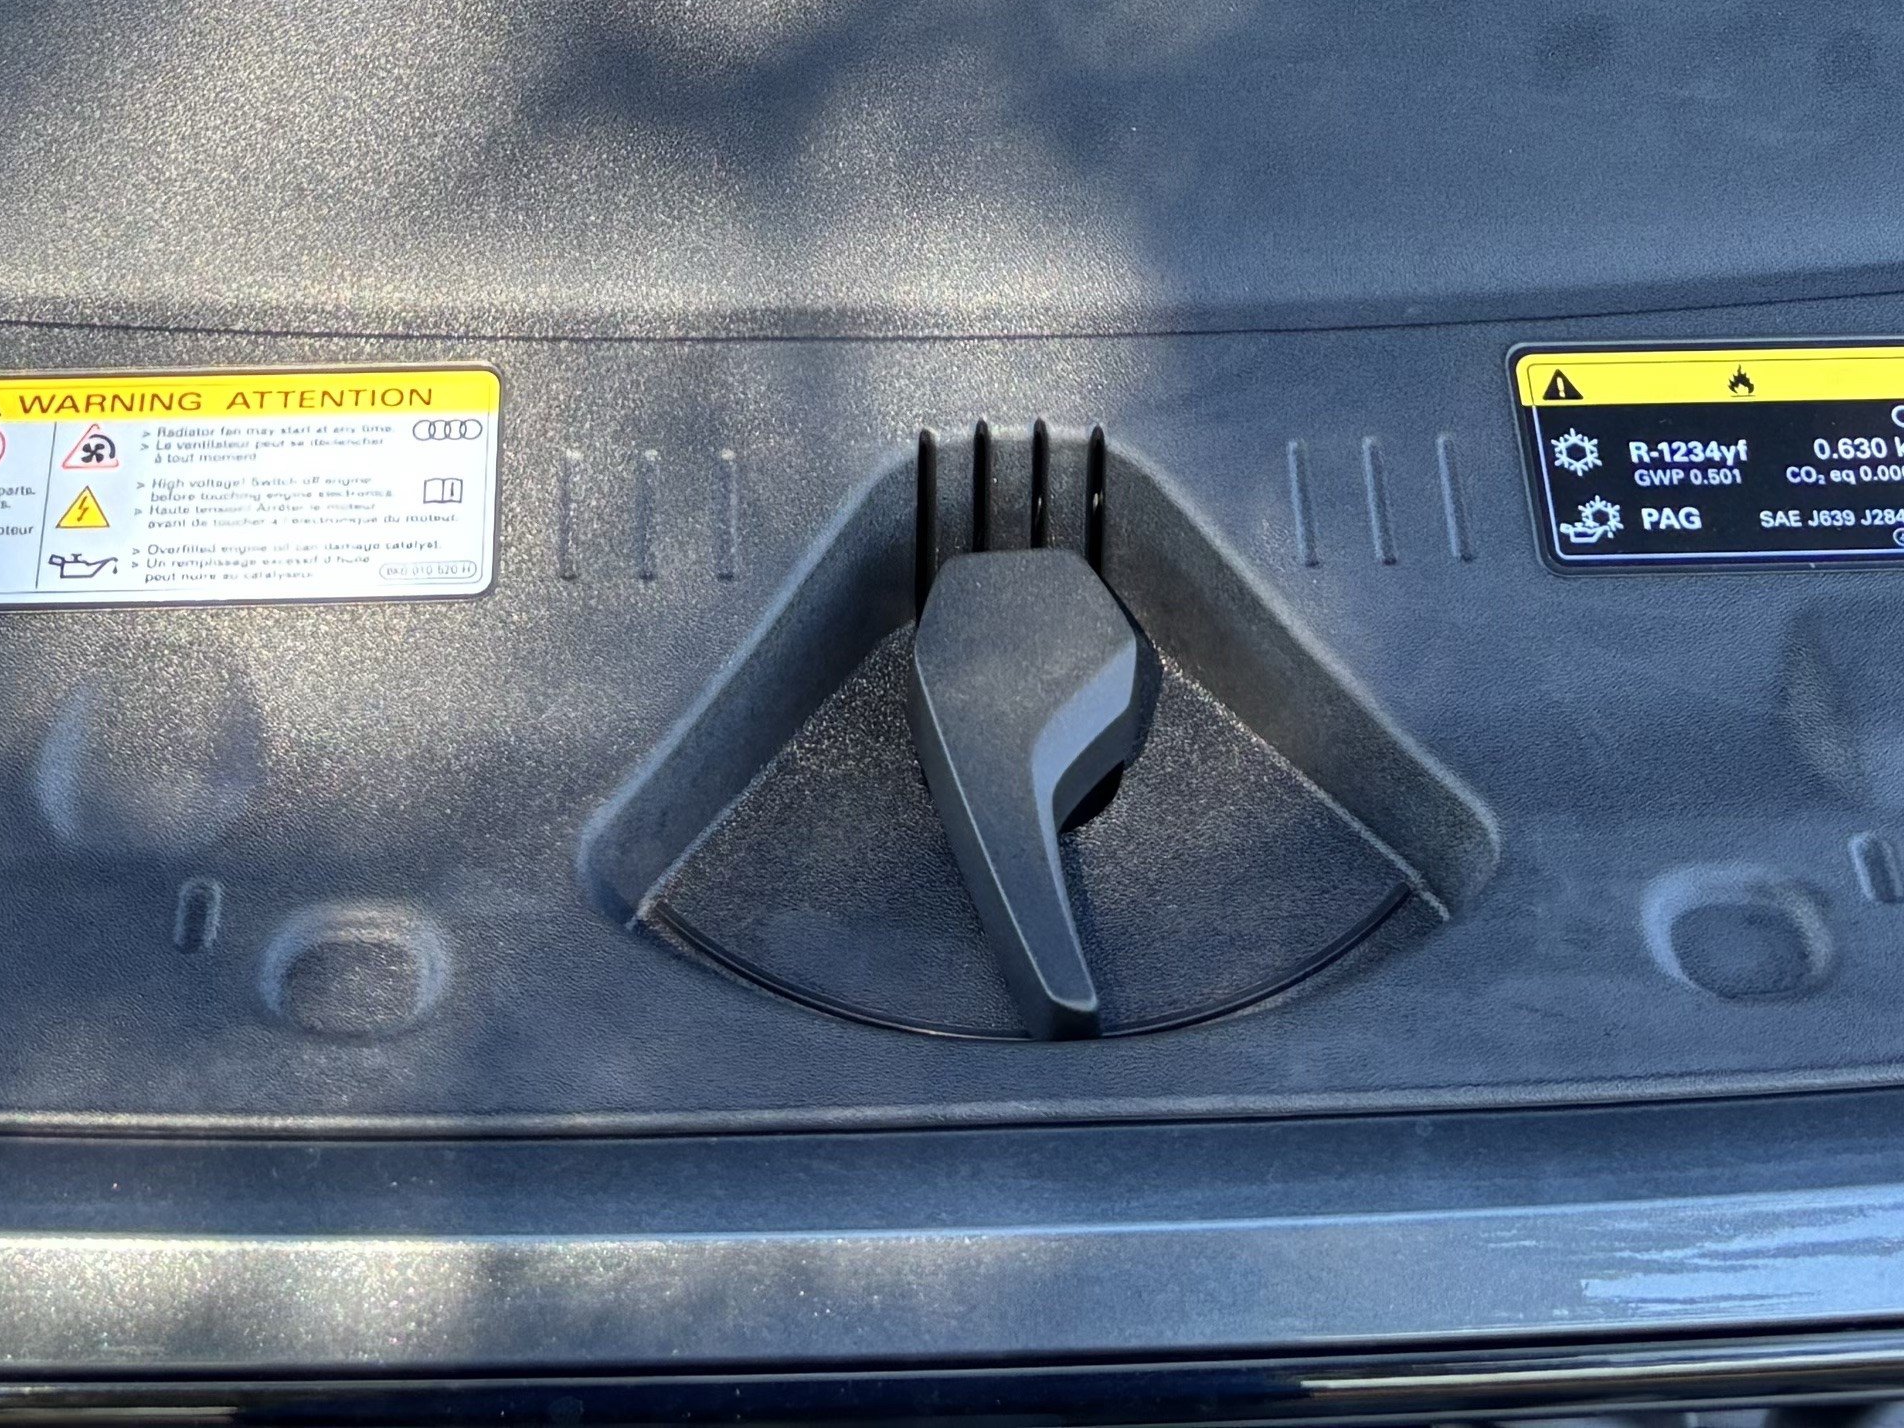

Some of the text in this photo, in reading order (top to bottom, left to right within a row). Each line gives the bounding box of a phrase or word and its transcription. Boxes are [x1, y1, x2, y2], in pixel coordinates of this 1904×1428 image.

[19, 388, 433, 414] WARNING ATTENTION
[158, 427, 215, 438] Radiator
[220, 427, 241, 436] fan
[246, 428, 274, 437] may
[155, 439, 172, 450] Le
[176, 439, 250, 450] ventilateur
[1629, 440, 1749, 465] R-1234yf
[1813, 437, 1888, 462] 0.630
[154, 453, 162, 464] à
[167, 452, 194, 463] tout
[1634, 467, 1684, 487] GWP
[1690, 466, 1743, 486] 0.501
[1830, 468, 1857, 487] eq
[151, 478, 186, 492] High
[150, 490, 196, 502] before
[149, 504, 190, 516] Haute
[1641, 507, 1702, 531] PAG
[1759, 510, 1802, 528] SAE
[1808, 509, 1855, 527] J639
[148, 543, 216, 555] Overfilled
[147, 557, 168, 569] Un
[144, 571, 176, 584] peut
